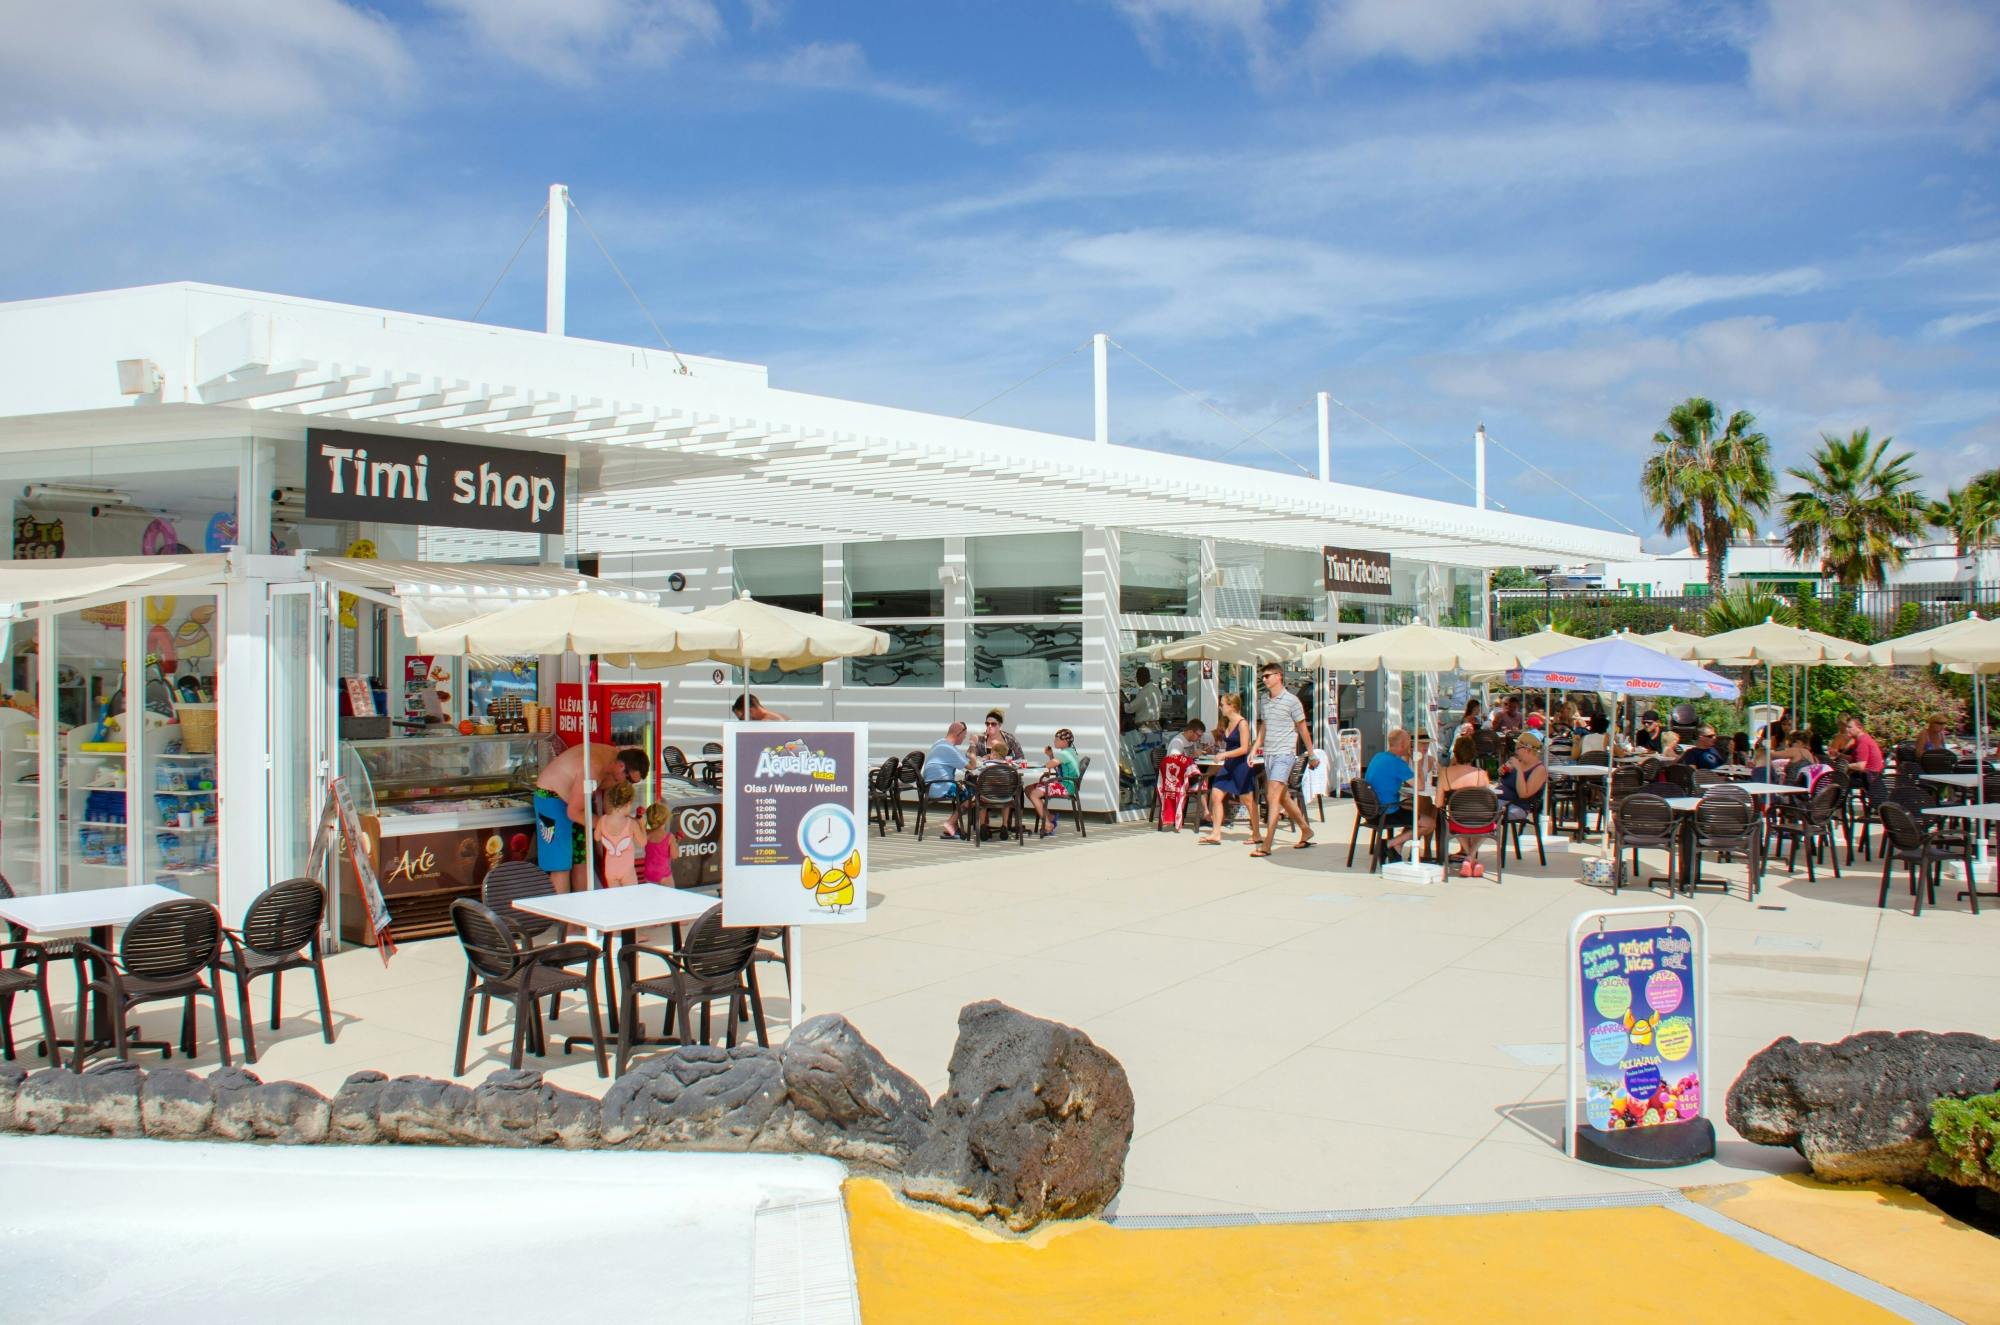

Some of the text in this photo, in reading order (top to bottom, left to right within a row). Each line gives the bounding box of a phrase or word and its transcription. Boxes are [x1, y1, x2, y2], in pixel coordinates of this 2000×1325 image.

[320, 444, 556, 523] Timi shop
[560, 714, 598, 734] BIEN FÍA
[744, 784, 767, 793] Olas
[774, 784, 807, 793] Waves
[814, 784, 848, 793] Wellen
[678, 842, 717, 857] FRIGO
[388, 847, 436, 883] Arte
